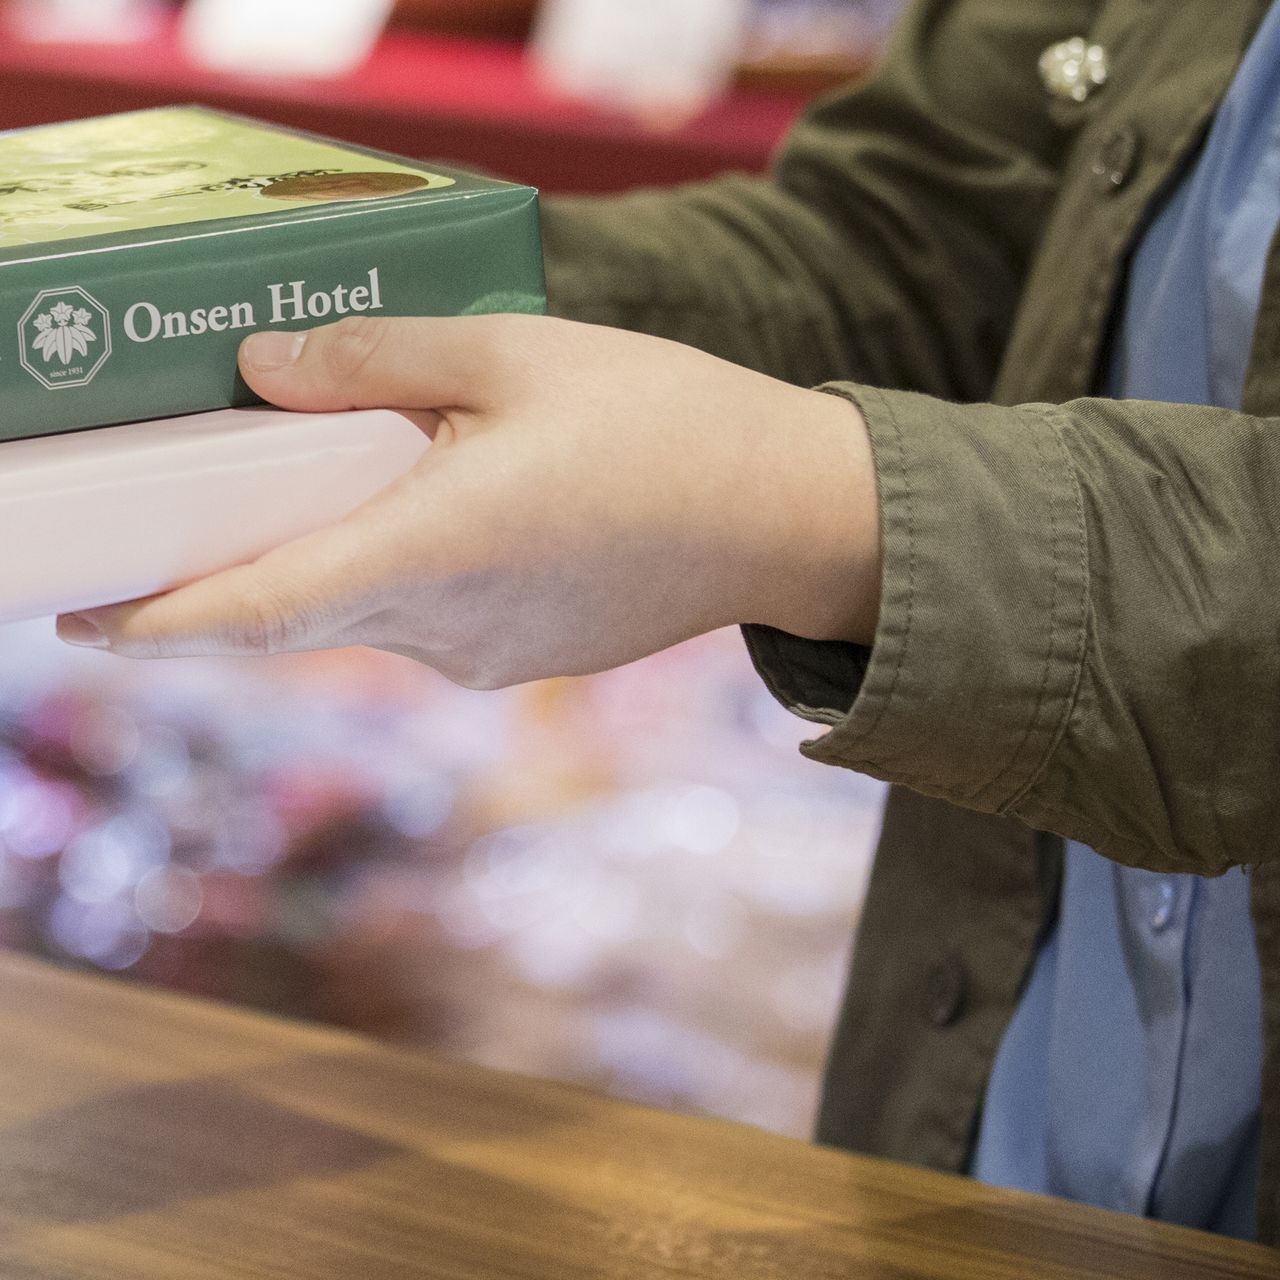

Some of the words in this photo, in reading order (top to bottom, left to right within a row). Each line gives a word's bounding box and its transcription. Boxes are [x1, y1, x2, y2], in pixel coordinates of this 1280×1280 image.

[123, 301, 257, 343] Onsen
[267, 267, 384, 323] Hotel
[49, 370, 68, 379] since
[68, 367, 83, 376] 1931
